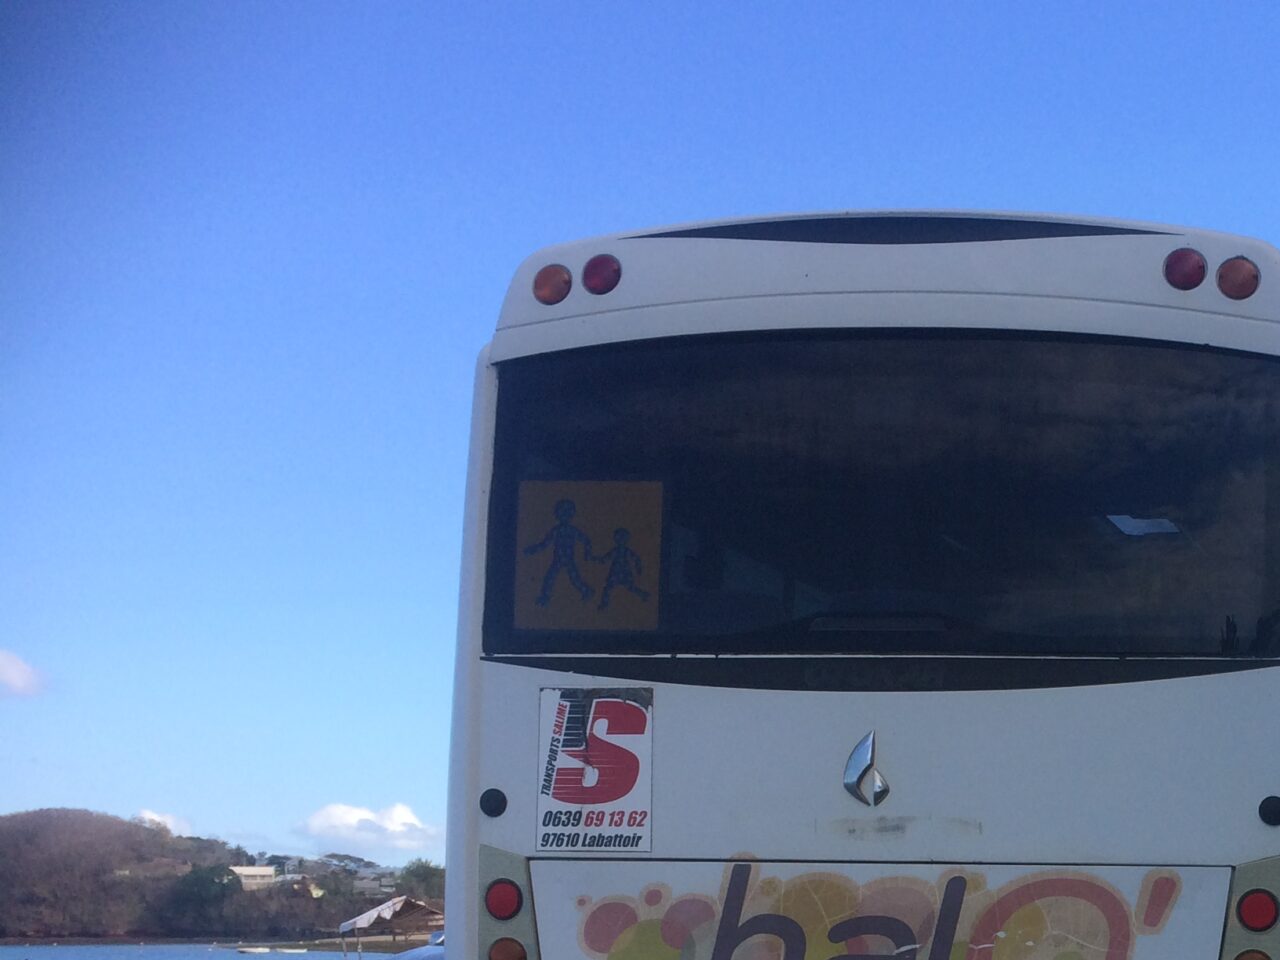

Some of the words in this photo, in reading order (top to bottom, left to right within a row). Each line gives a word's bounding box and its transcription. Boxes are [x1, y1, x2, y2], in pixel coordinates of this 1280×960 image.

[540, 736, 561, 796] TRANSPORTS
[542, 810, 582, 827] 0639
[584, 810, 605, 827] 69
[608, 810, 625, 827] 13
[627, 810, 648, 827] 62
[540, 832, 580, 848] 97610
[581, 833, 642, 848] Labattoir
